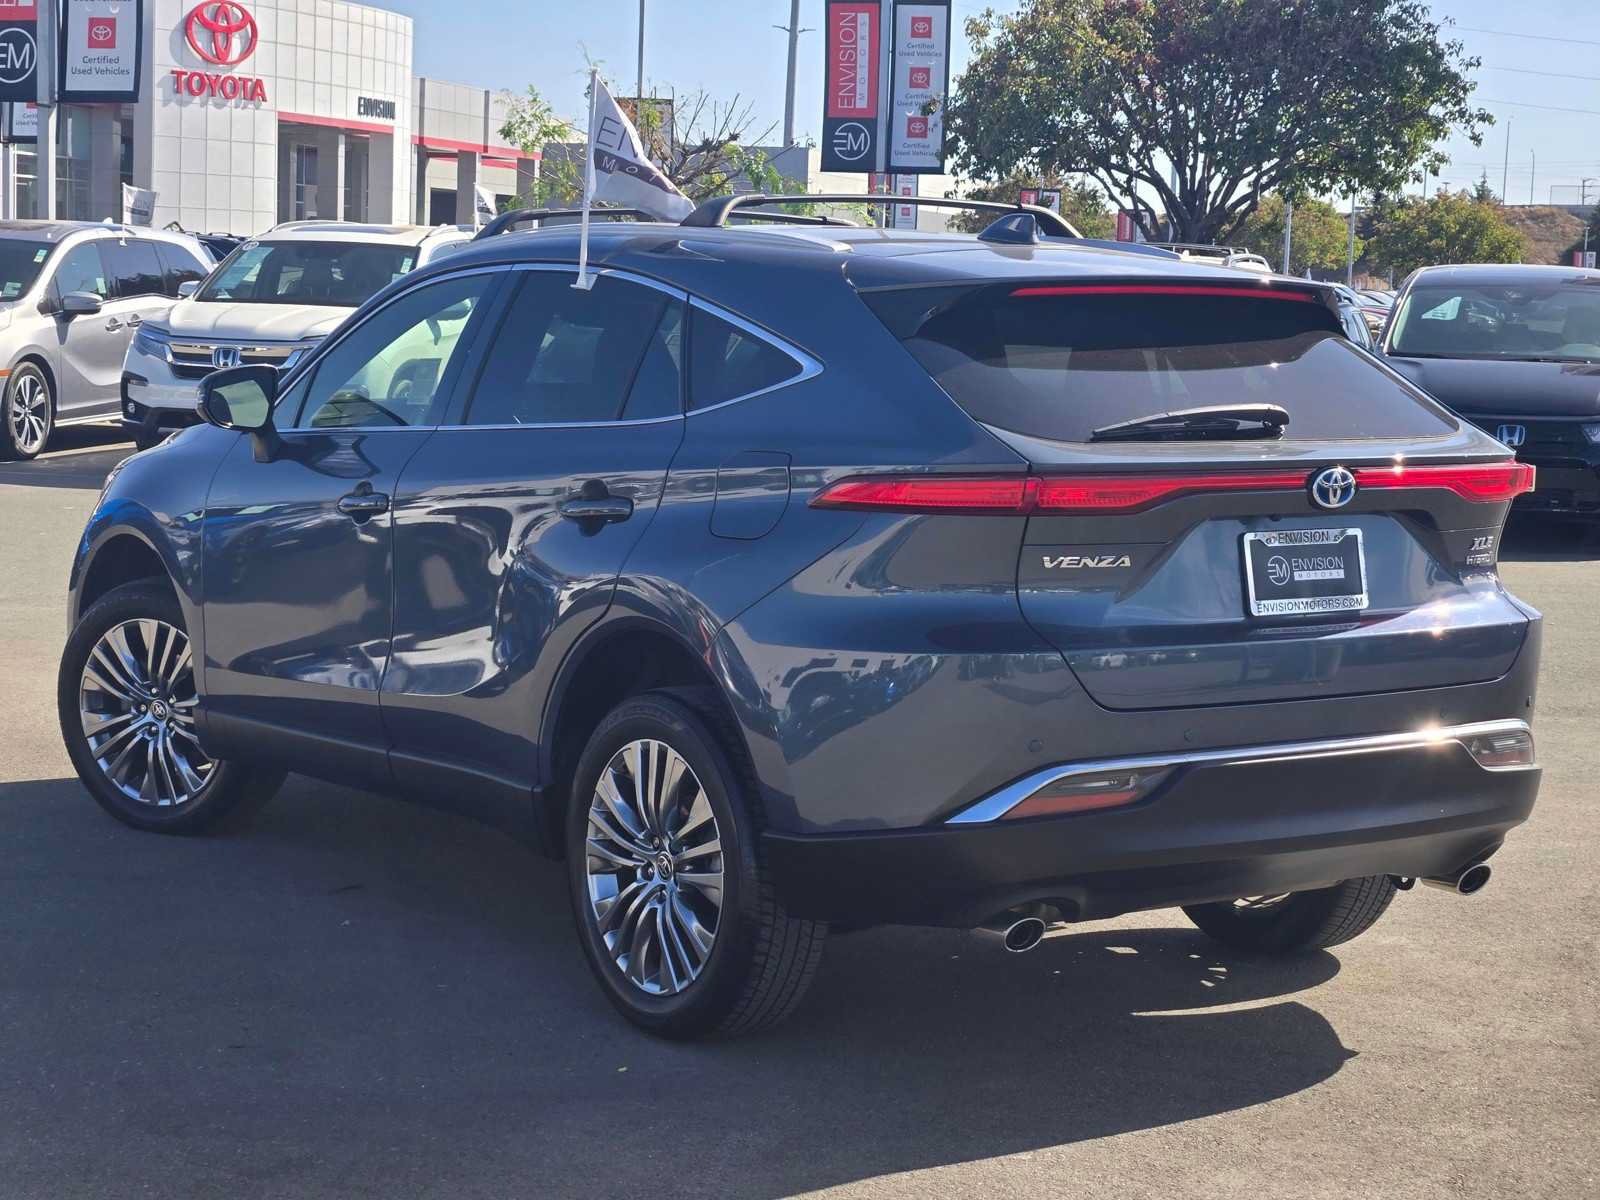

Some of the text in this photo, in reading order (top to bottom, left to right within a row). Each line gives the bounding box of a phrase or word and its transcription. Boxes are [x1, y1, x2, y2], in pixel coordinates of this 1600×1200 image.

[82, 55, 120, 65] Certified
[838, 12, 857, 109] ENVISION
[859, 19, 867, 101] MOTORS
[71, 66, 130, 76] Used Vehicles
[170, 70, 267, 102] TOYOTA
[357, 96, 396, 121] ENVISION
[1278, 531, 1329, 545] ENVISION
[1043, 555, 1131, 568] VENZA
[1292, 556, 1344, 571] ENVISION
